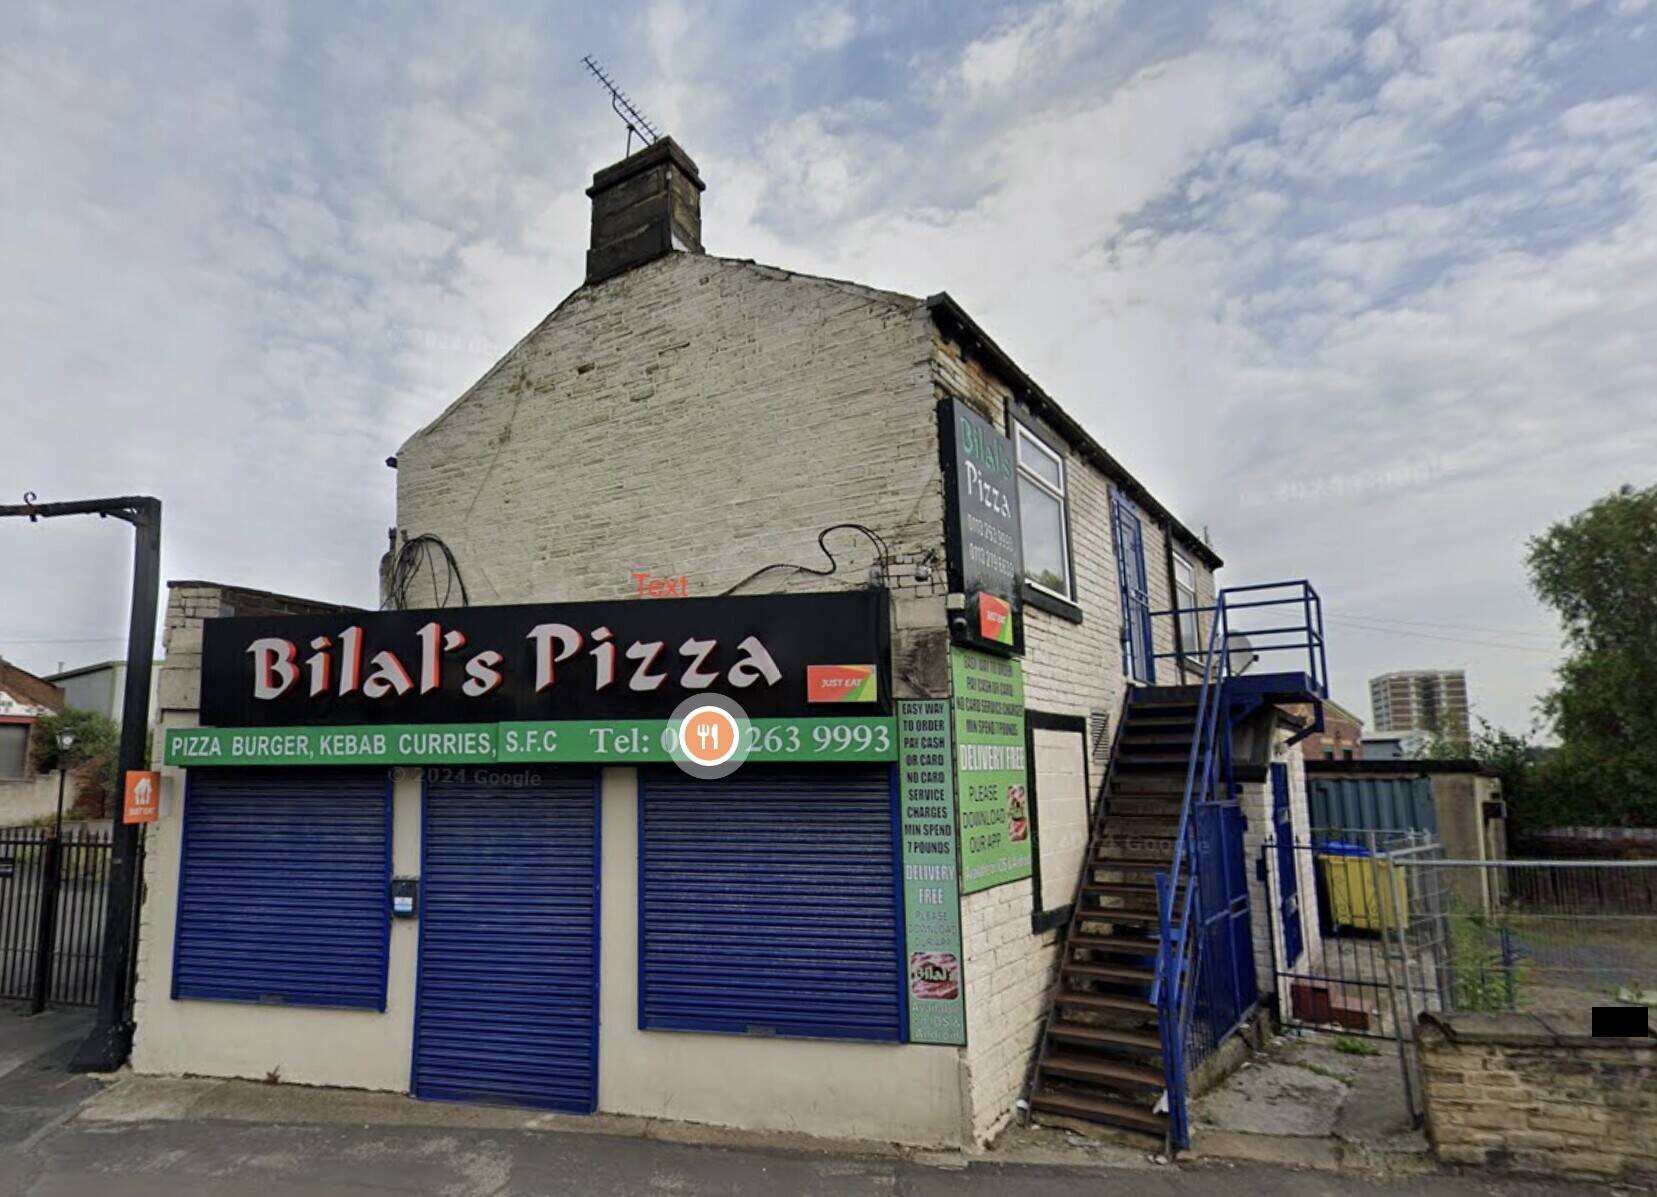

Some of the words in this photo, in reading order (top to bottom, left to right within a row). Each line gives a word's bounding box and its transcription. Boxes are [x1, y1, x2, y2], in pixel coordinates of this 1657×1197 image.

[964, 459, 1011, 519] Pizza
[246, 621, 503, 700] Bilal's
[526, 623, 783, 693] Pizza
[820, 679, 843, 688] JUST
[844, 678, 862, 687] EAT
[902, 703, 922, 715] EASY
[925, 703, 944, 715] WAY
[903, 720, 913, 732] TO
[916, 720, 945, 732] ORDER
[171, 736, 221, 757] PIZZA
[232, 735, 314, 759] BURGER,
[320, 734, 386, 756] KEBAB
[399, 732, 497, 759] CURRIES,
[505, 730, 557, 753] S.F.C
[589, 727, 650, 753] Tel:
[745, 726, 800, 752] 263
[812, 725, 891, 752] 9993
[904, 737, 919, 749] PAY
[921, 737, 945, 749] CASH
[906, 754, 918, 766] OR
[920, 754, 944, 766] CARD
[960, 744, 1004, 771] DELIVERY
[1006, 746, 1024, 771] FREE
[907, 771, 920, 783] NO
[921, 771, 945, 783] CARD
[908, 789, 945, 801] SERVICE
[968, 785, 998, 802] PLEASE
[907, 806, 948, 819] CHARGES
[962, 808, 1006, 829] DOWNLOAD
[905, 824, 921, 836] MIN
[923, 824, 952, 837] SPEND
[914, 842, 950, 854] POUNDS
[969, 836, 987, 854] OUR
[988, 833, 1001, 849] APP
[905, 864, 955, 881] DELIVERY
[919, 888, 944, 904] FREE
